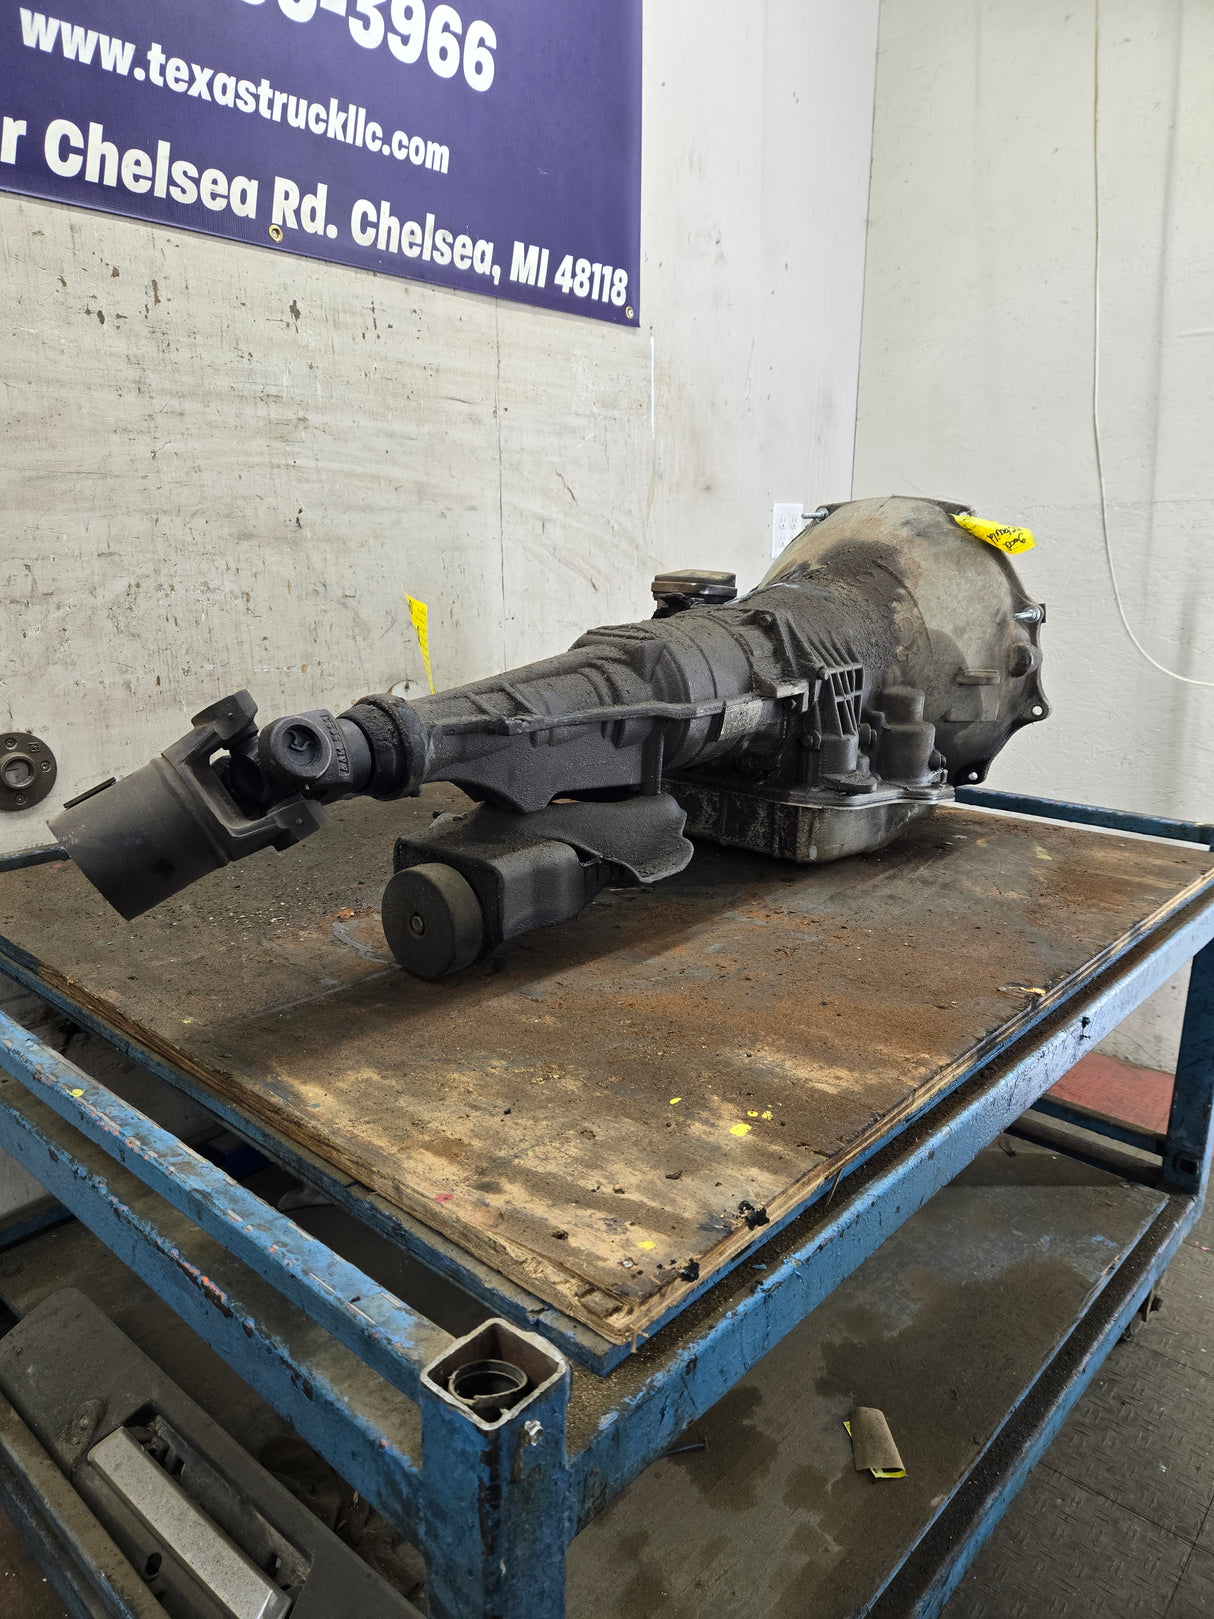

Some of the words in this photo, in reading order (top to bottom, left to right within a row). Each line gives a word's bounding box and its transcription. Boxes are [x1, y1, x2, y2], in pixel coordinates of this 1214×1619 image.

[19, 7, 451, 174] www.texastruckllc.com
[240, 0, 497, 92] -3966
[44, 118, 259, 220] Chelsea
[271, 176, 339, 240] Rd.
[350, 198, 502, 286] Chelsea,
[510, 240, 549, 289] MI
[554, 254, 629, 307] 48118
